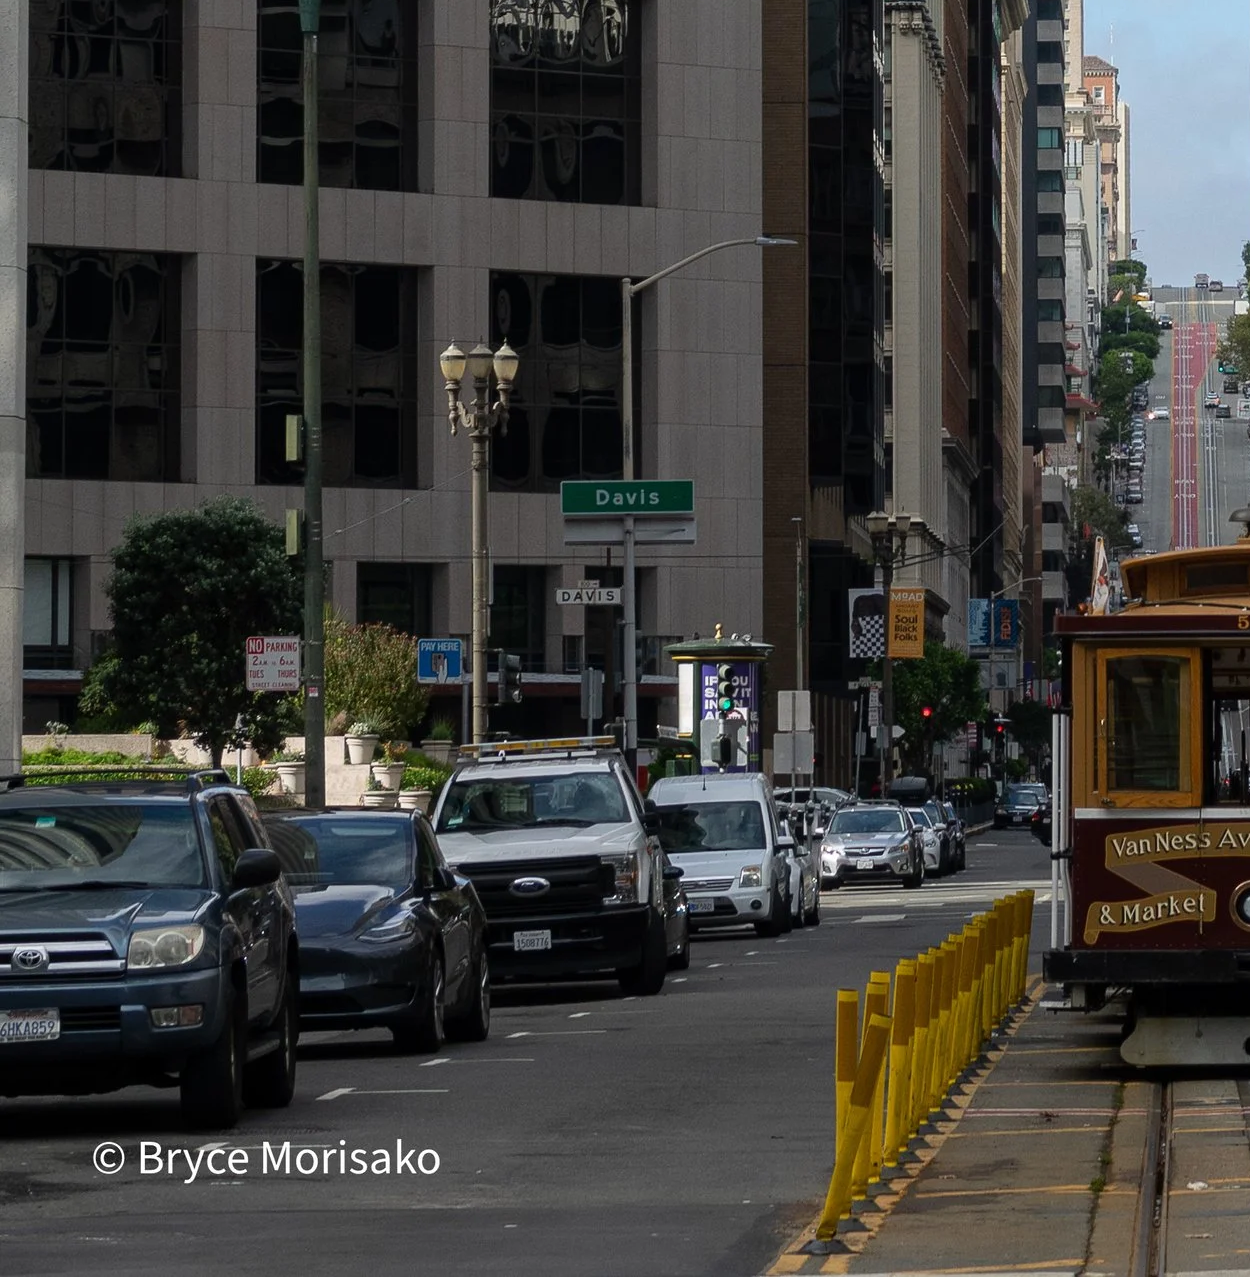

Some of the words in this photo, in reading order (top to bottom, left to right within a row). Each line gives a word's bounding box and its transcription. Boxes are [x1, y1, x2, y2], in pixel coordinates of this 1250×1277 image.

[596, 489, 660, 506] Davis
[562, 591, 615, 602] DAVIS
[895, 614, 918, 623] Soul
[895, 624, 918, 633] Black
[894, 633, 918, 641] Folks
[249, 639, 263, 653] NO
[266, 641, 298, 652] PARKING
[421, 642, 436, 651] PAY
[437, 642, 459, 651] HERE
[249, 669, 265, 679] TUES
[278, 669, 297, 678] THURS
[1112, 838, 1151, 858] Van
[1154, 831, 1211, 853] Ness
[1100, 904, 1116, 925] &
[1122, 893, 1205, 925] Market
[0, 1020, 55, 1037] 6HKA859
